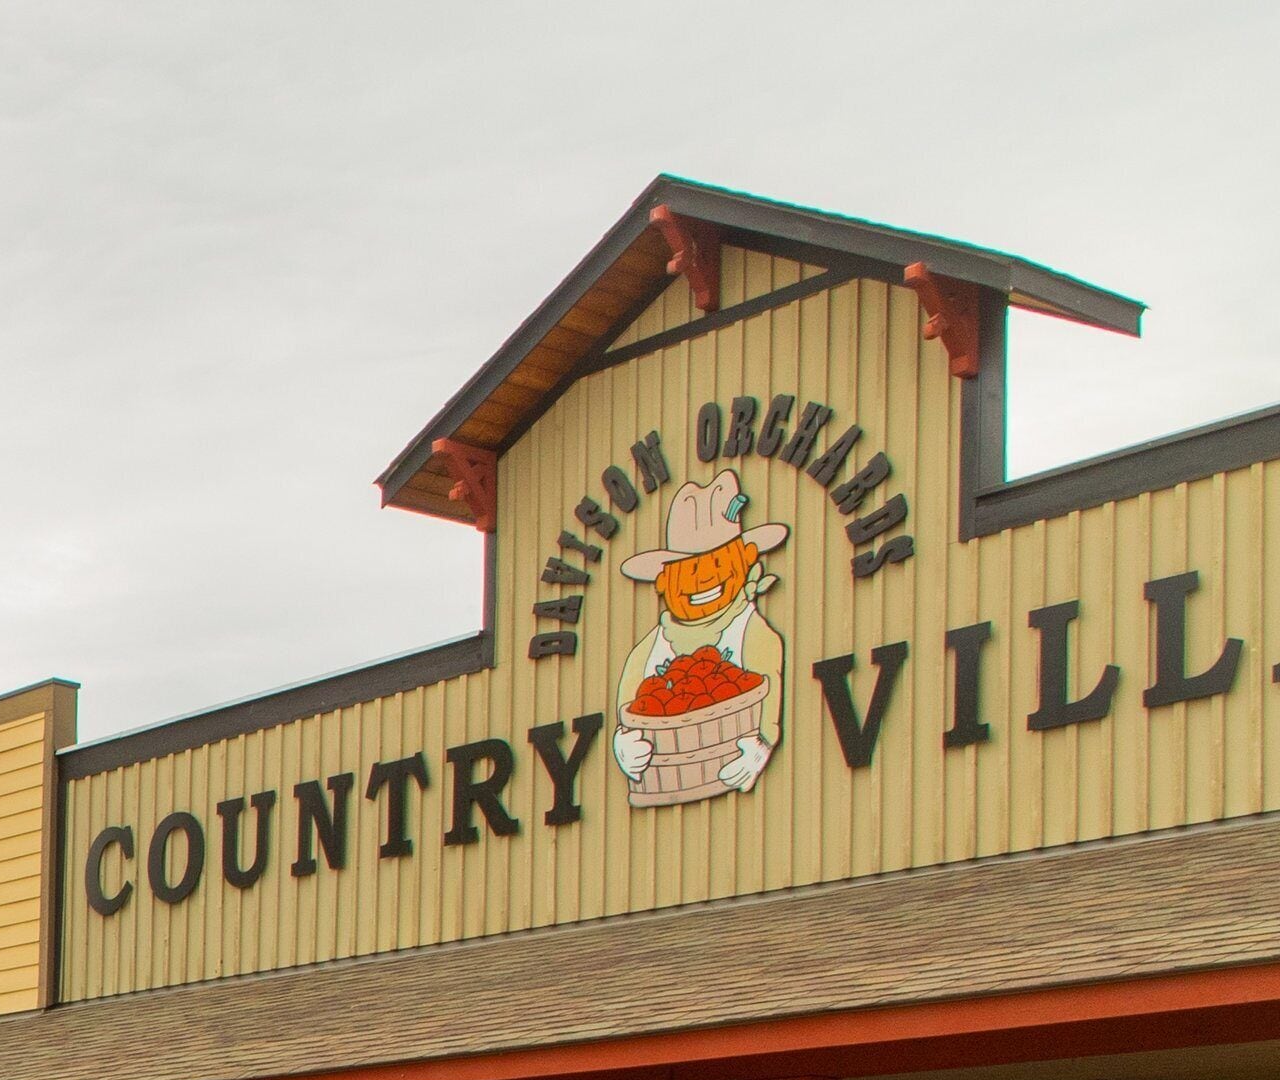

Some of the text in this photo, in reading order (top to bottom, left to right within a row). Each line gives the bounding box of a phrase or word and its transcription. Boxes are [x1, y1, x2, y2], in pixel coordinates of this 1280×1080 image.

[528, 394, 915, 661] DAVISON ORCHARDS
[85, 570, 1280, 916] COUNTRY VILL
